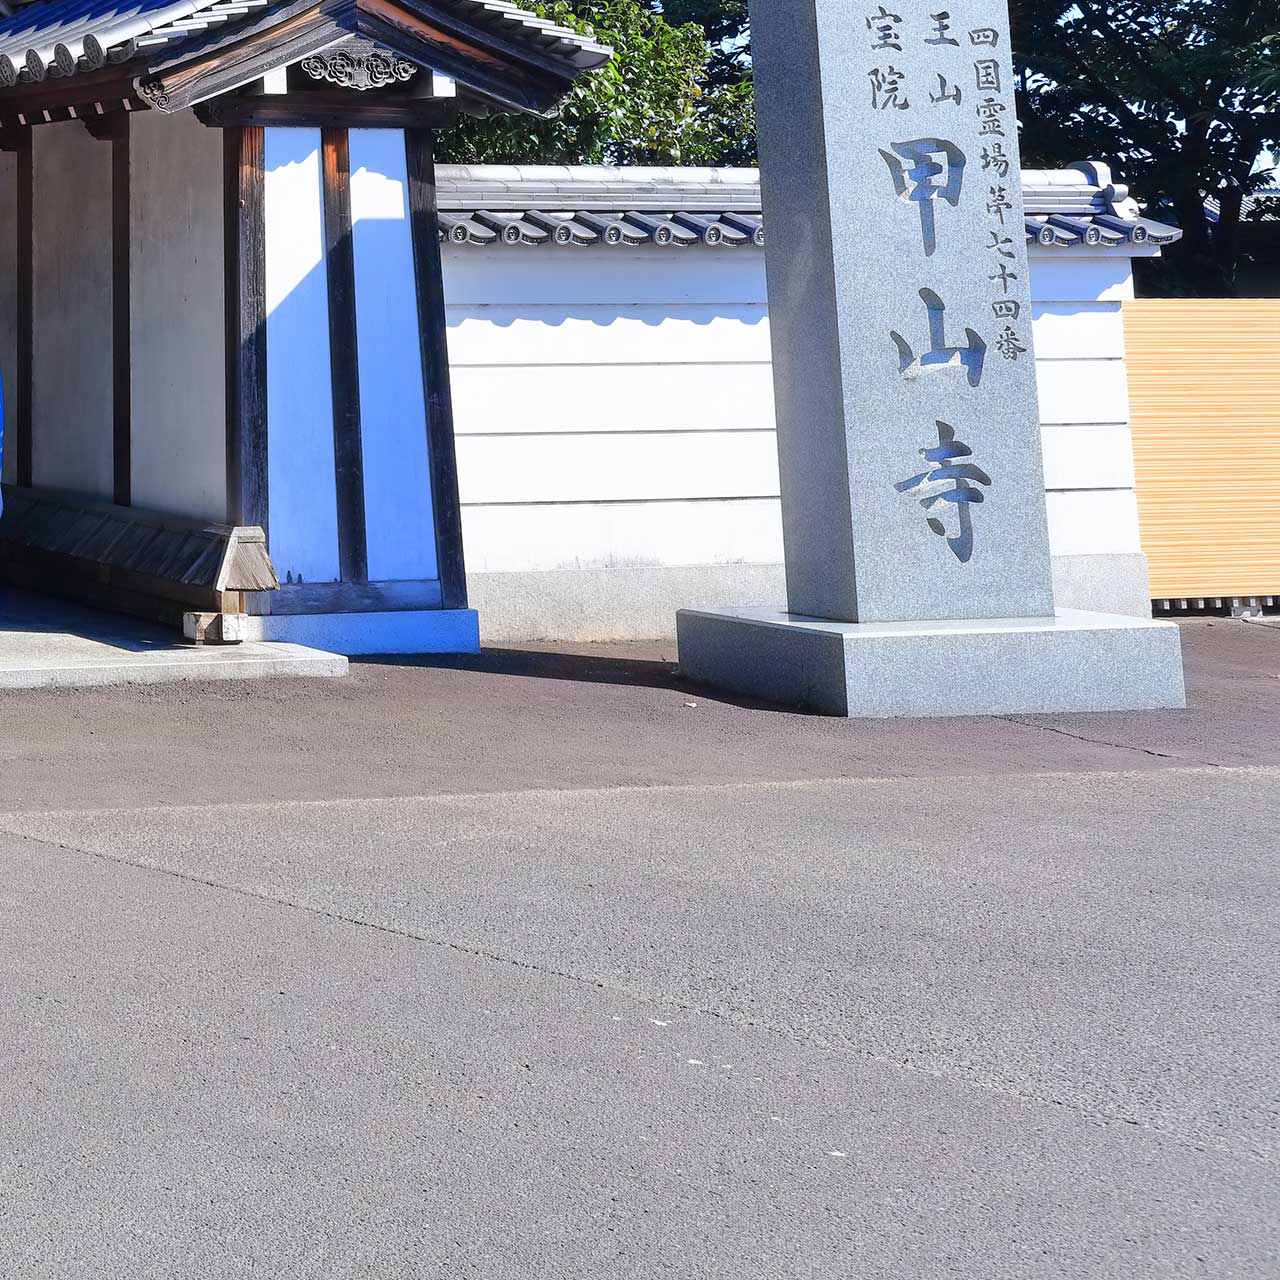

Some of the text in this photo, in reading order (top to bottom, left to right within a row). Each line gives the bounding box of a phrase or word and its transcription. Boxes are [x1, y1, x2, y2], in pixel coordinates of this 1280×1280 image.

[878, 137, 992, 564] 甲山寺
[968, 27, 1027, 360] 四国霊場第七十四番
